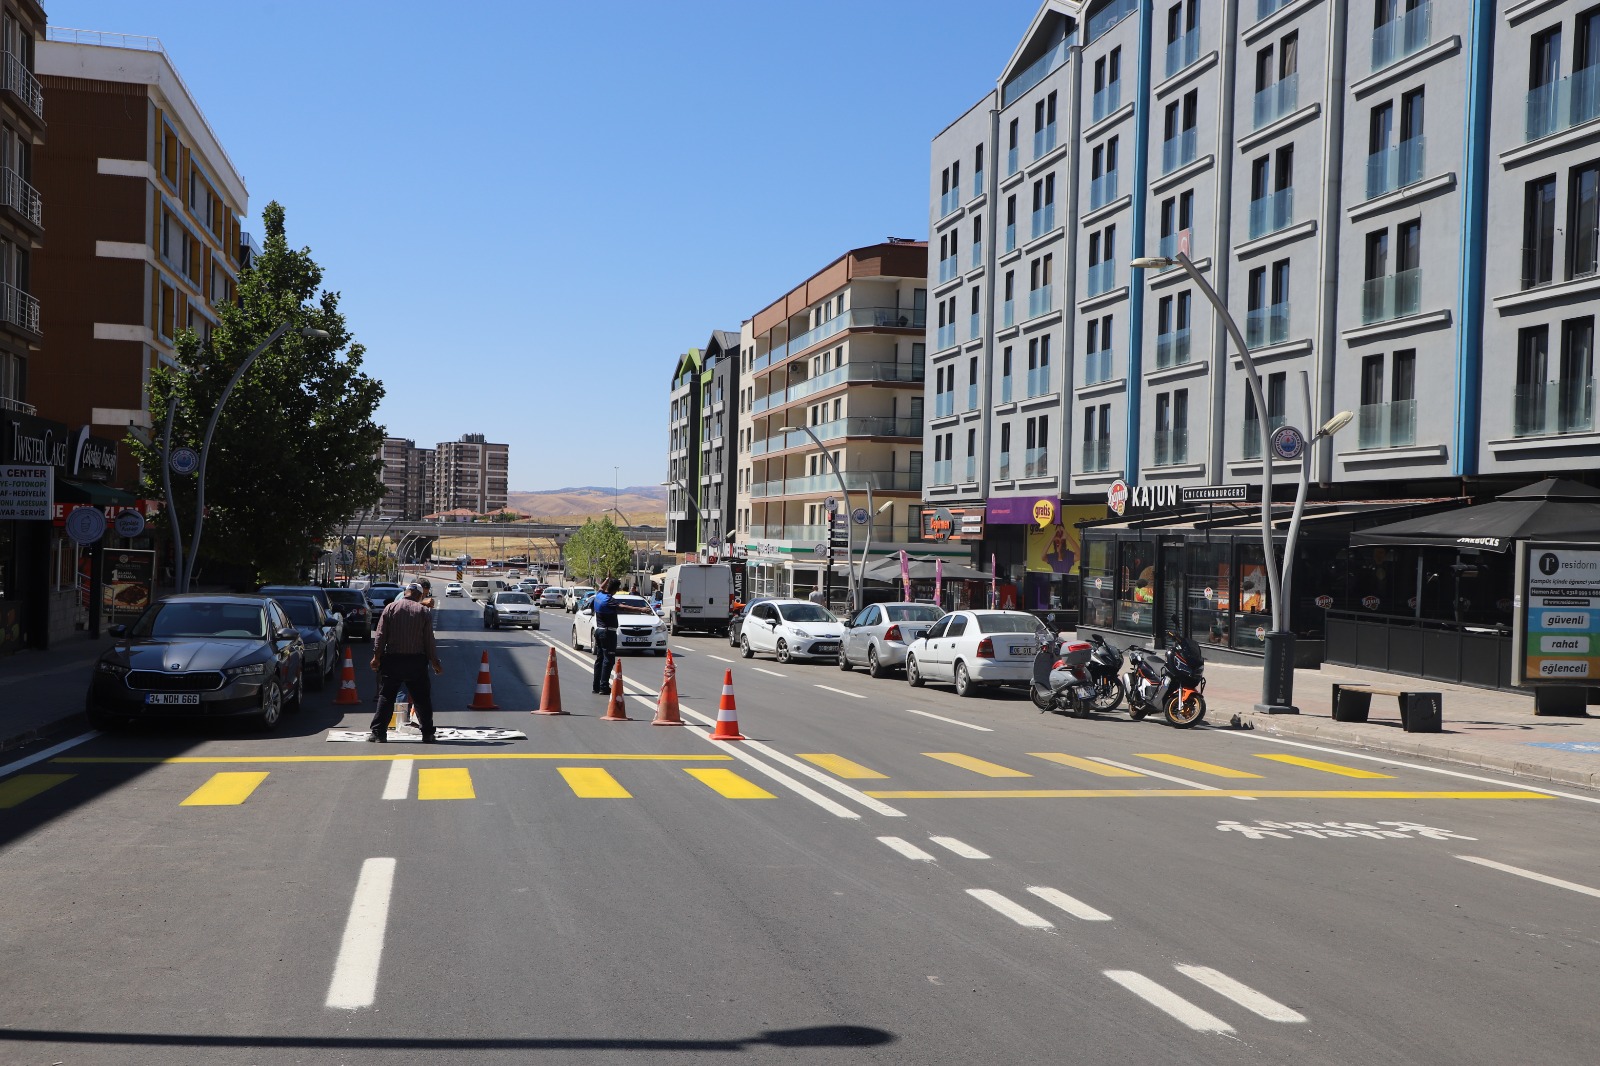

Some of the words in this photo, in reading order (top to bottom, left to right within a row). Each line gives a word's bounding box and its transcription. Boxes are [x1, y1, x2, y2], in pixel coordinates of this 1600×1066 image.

[7, 469, 47, 478] CENTER
[1132, 485, 1177, 511] KAJUN
[1184, 488, 1245, 499] CHICKEN&BURGERS
[1034, 504, 1051, 518] gratis
[1561, 560, 1597, 570] residorm
[1547, 615, 1584, 626] güvenli
[1551, 639, 1579, 649] rahat
[1542, 663, 1587, 675] eğlenceli
[150, 694, 160, 704] 34
[182, 694, 198, 704] 666
